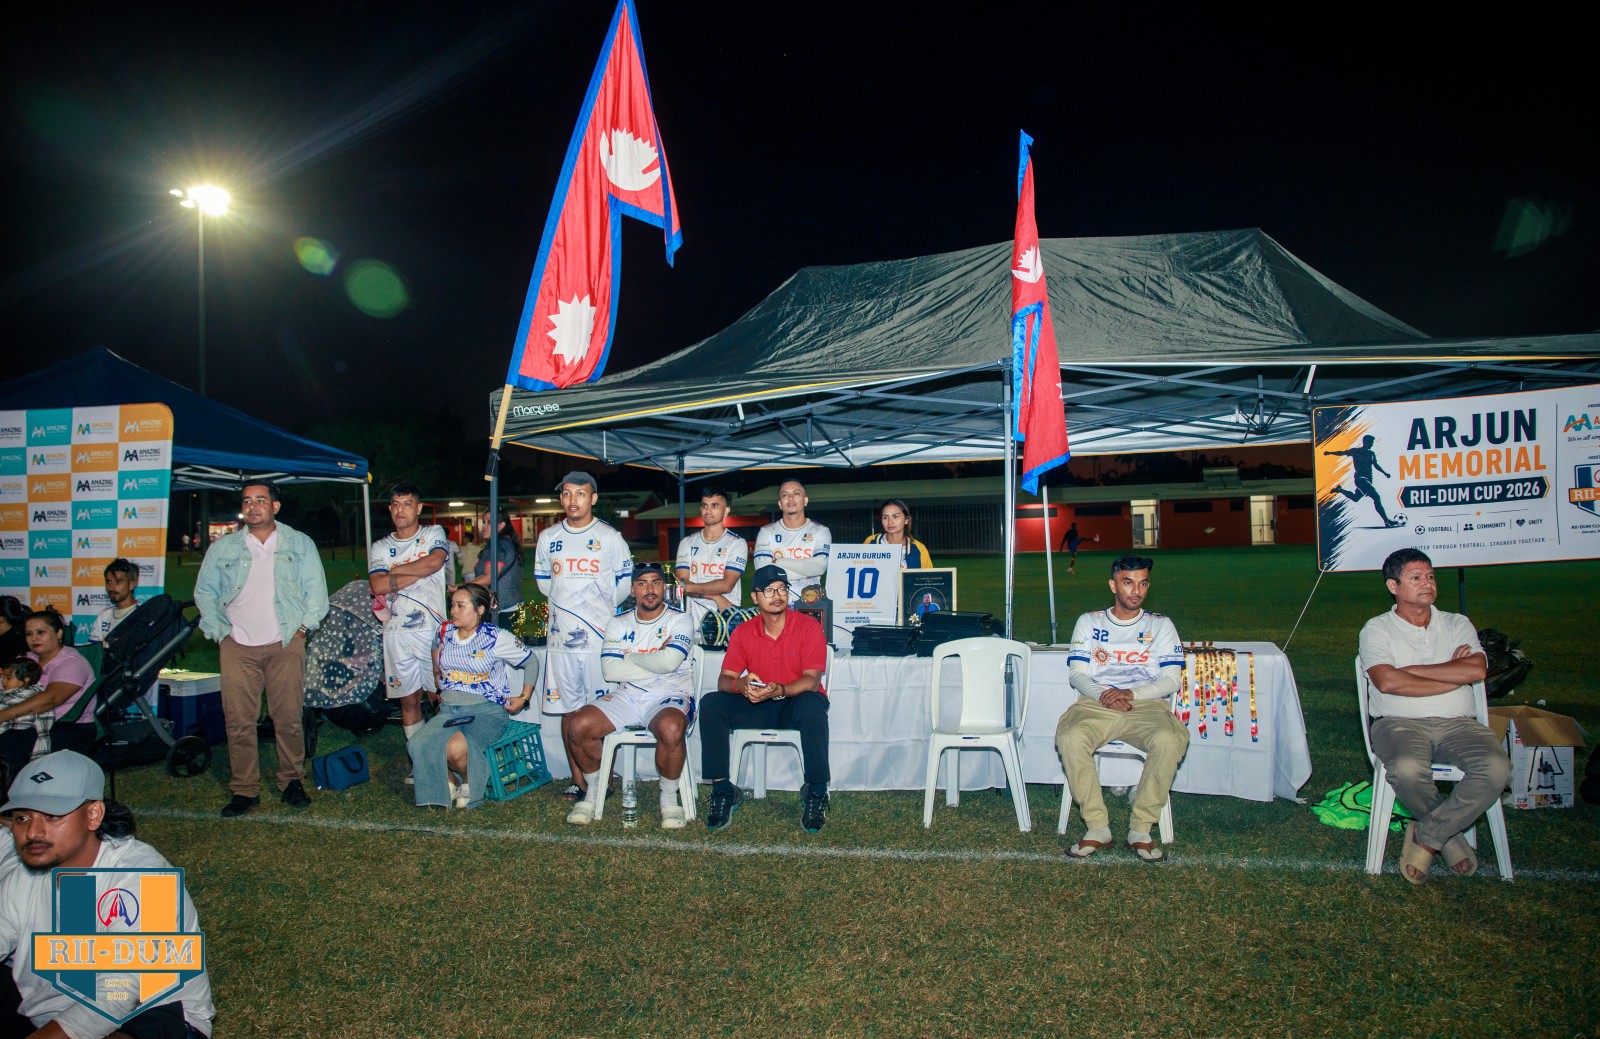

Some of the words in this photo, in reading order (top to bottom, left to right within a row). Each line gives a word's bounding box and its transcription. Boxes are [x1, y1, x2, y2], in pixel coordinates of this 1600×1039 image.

[1407, 408, 1536, 450] ARJUN
[1399, 445, 1546, 480] MEMORIAL
[1410, 487, 1469, 504] RII-DUM
[1474, 485, 1502, 500] CUP
[1506, 481, 1540, 498] 2026
[1476, 522, 1506, 530] COMMUNITY
[389, 548, 397, 557] 9
[549, 540, 563, 553] 26
[787, 547, 812, 559] TCS
[837, 552, 861, 560] ARJUN
[862, 552, 892, 560] GURUNG
[566, 558, 600, 573] TCS
[701, 562, 725, 575] TCS
[845, 567, 880, 598] 10
[1092, 627, 1109, 642] 32
[1112, 649, 1151, 663] TCS
